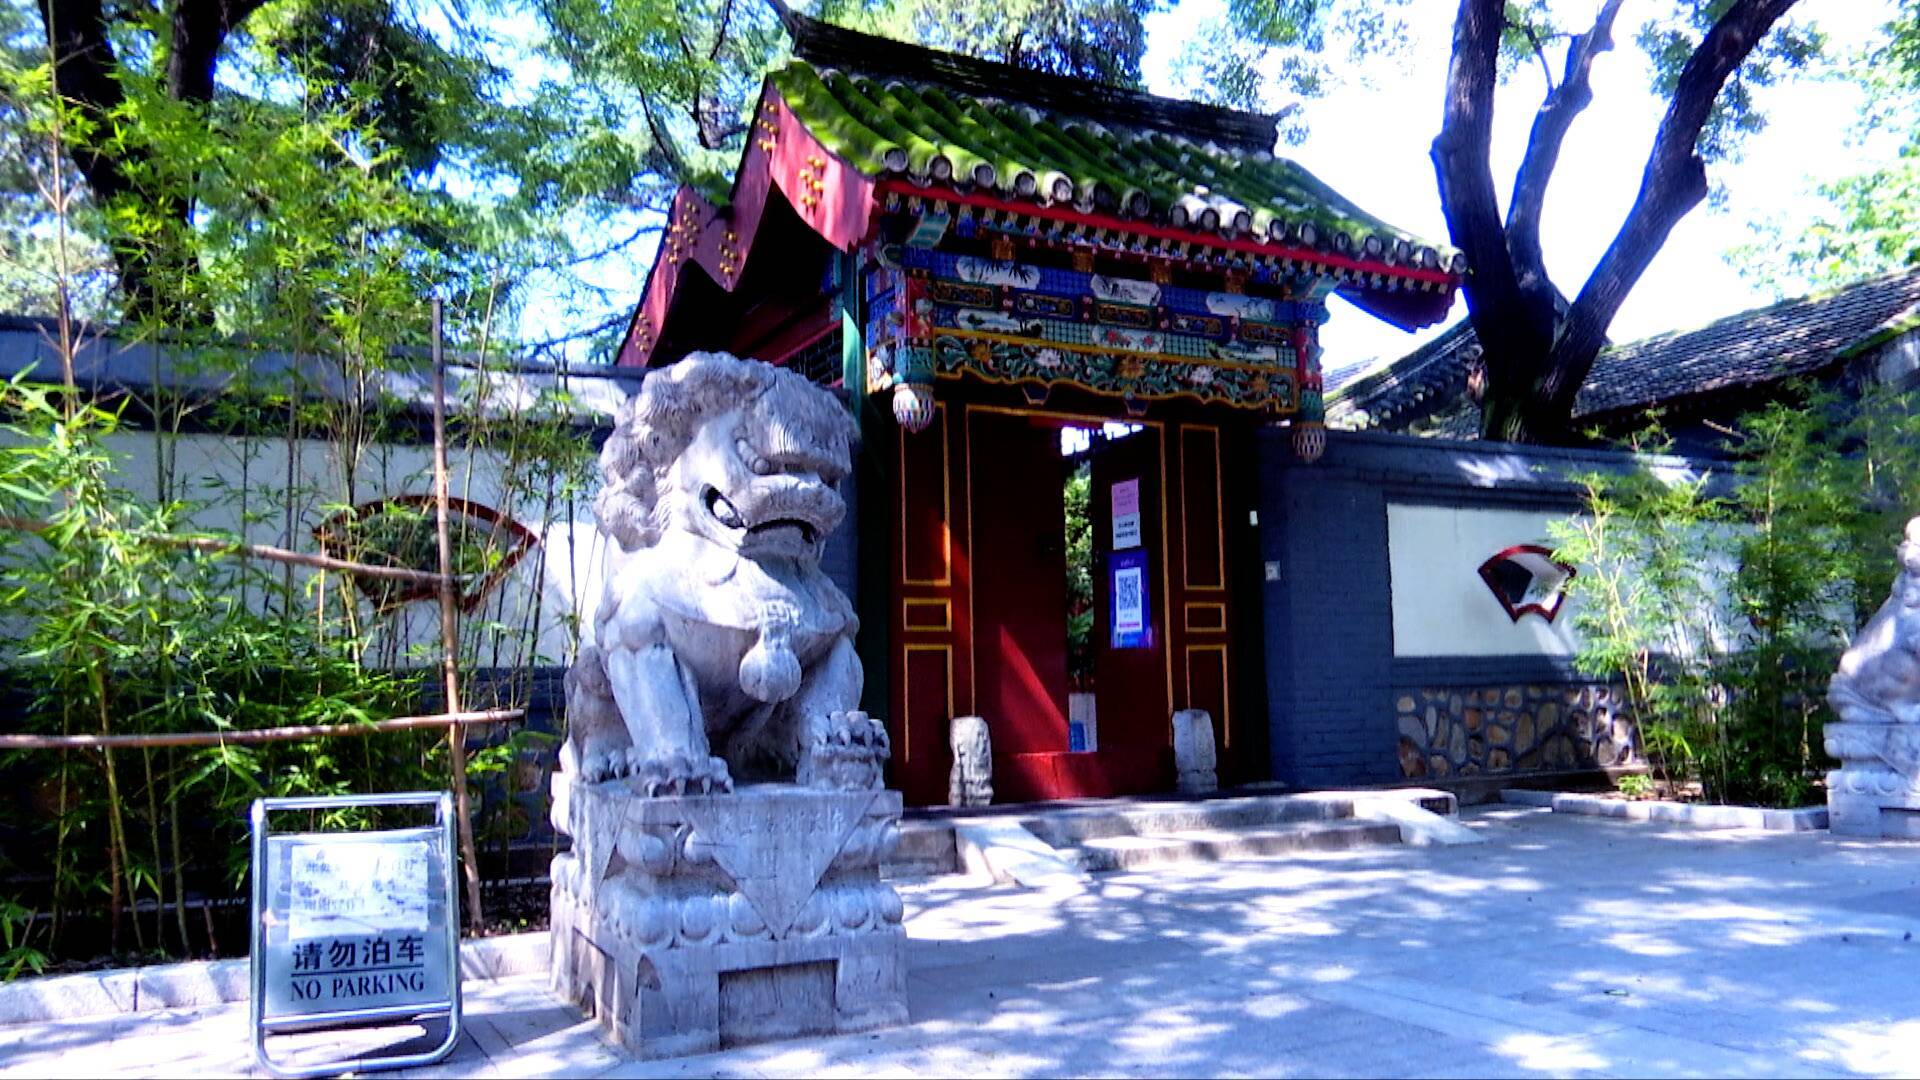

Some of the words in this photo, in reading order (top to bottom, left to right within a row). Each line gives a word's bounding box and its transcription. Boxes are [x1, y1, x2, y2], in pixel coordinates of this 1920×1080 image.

[292, 935, 424, 970] 请勿泊车
[290, 979, 322, 1001] NO
[332, 971, 424, 998] PARKING
